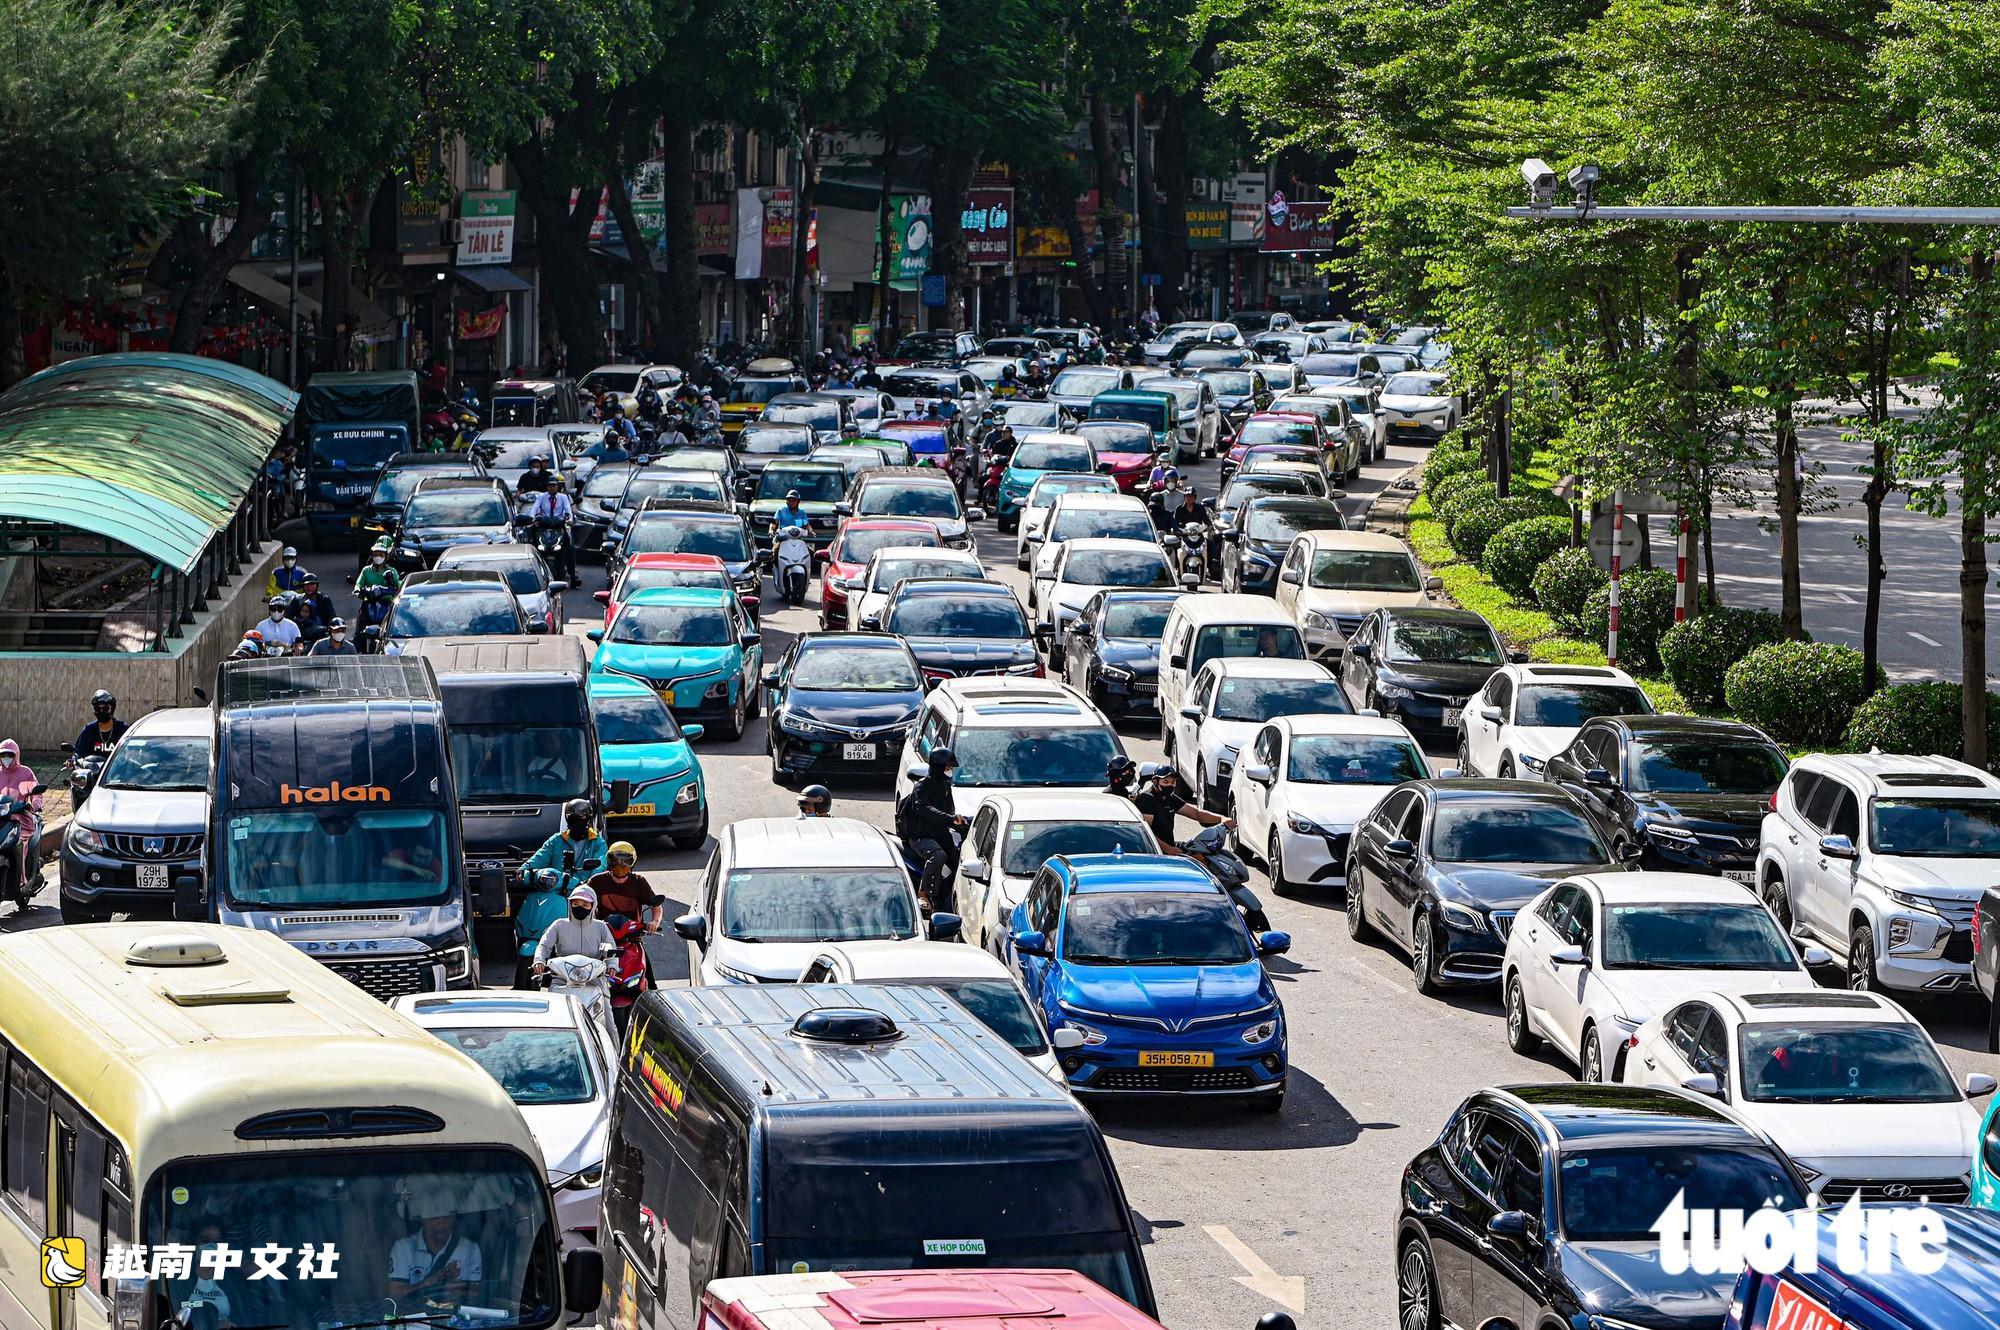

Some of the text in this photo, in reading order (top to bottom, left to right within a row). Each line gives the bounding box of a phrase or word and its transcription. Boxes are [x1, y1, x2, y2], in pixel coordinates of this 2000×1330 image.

[468, 230, 504, 254] TÂN LÊ
[333, 431, 343, 439] XE
[94, 742, 115, 752] FILA
[281, 780, 391, 805] halan
[143, 865, 161, 876] 29H
[138, 877, 168, 887] 197.35
[306, 941, 378, 951] DCAR
[1145, 1053, 1207, 1065] 35H-058.71
[926, 1240, 984, 1254] XE HỢP ĐỒNG
